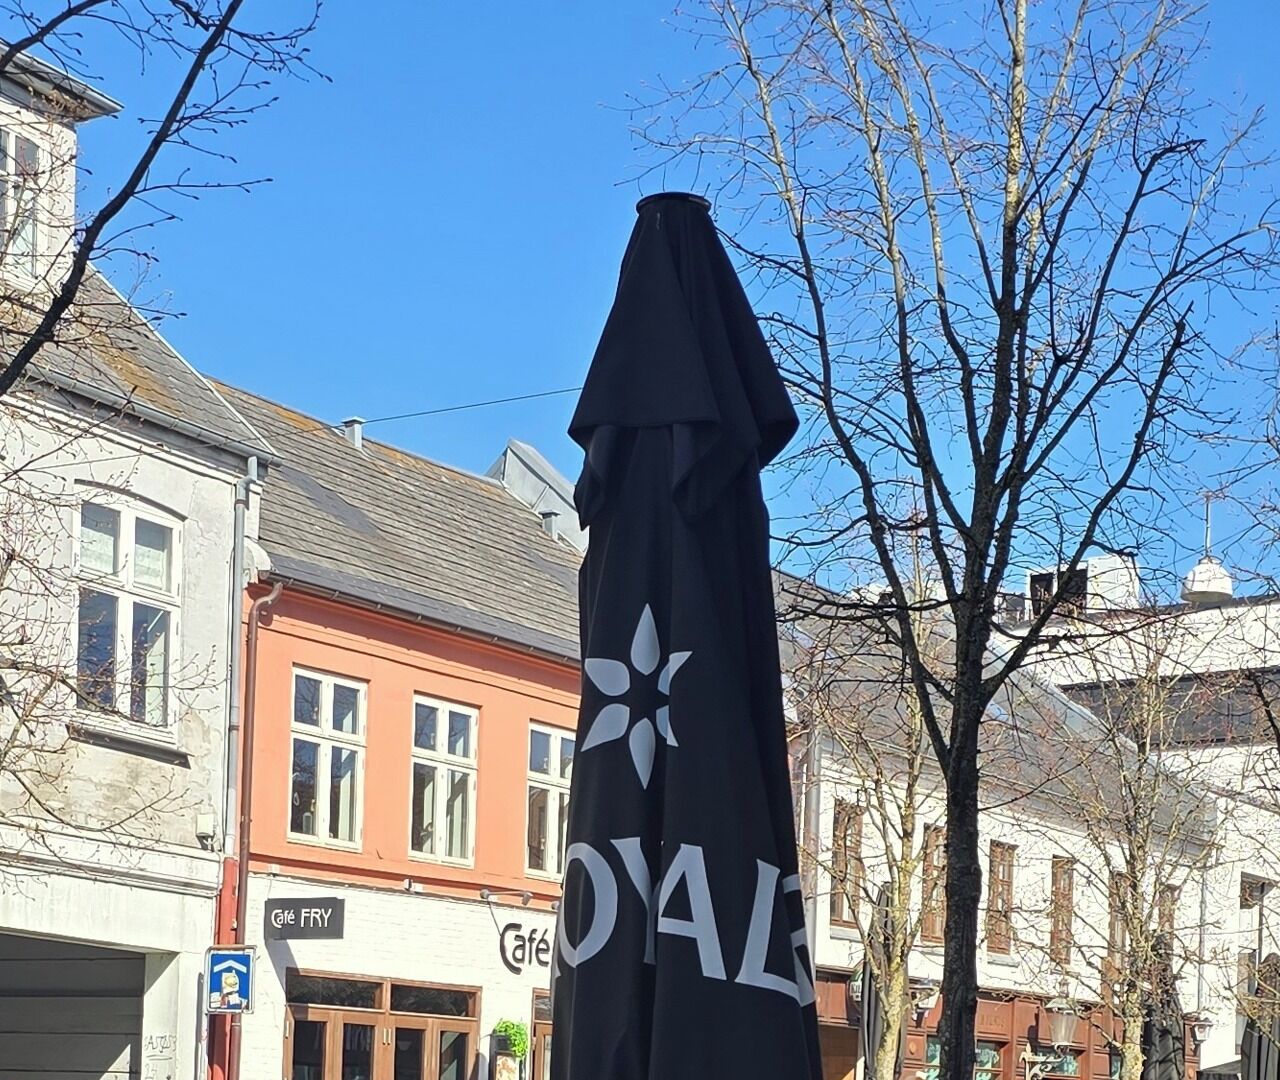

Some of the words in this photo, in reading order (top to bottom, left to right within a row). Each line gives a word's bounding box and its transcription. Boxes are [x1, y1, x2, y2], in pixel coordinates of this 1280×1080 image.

[271, 908, 296, 929] Café
[300, 907, 333, 928] FRY
[499, 922, 551, 975] Café
